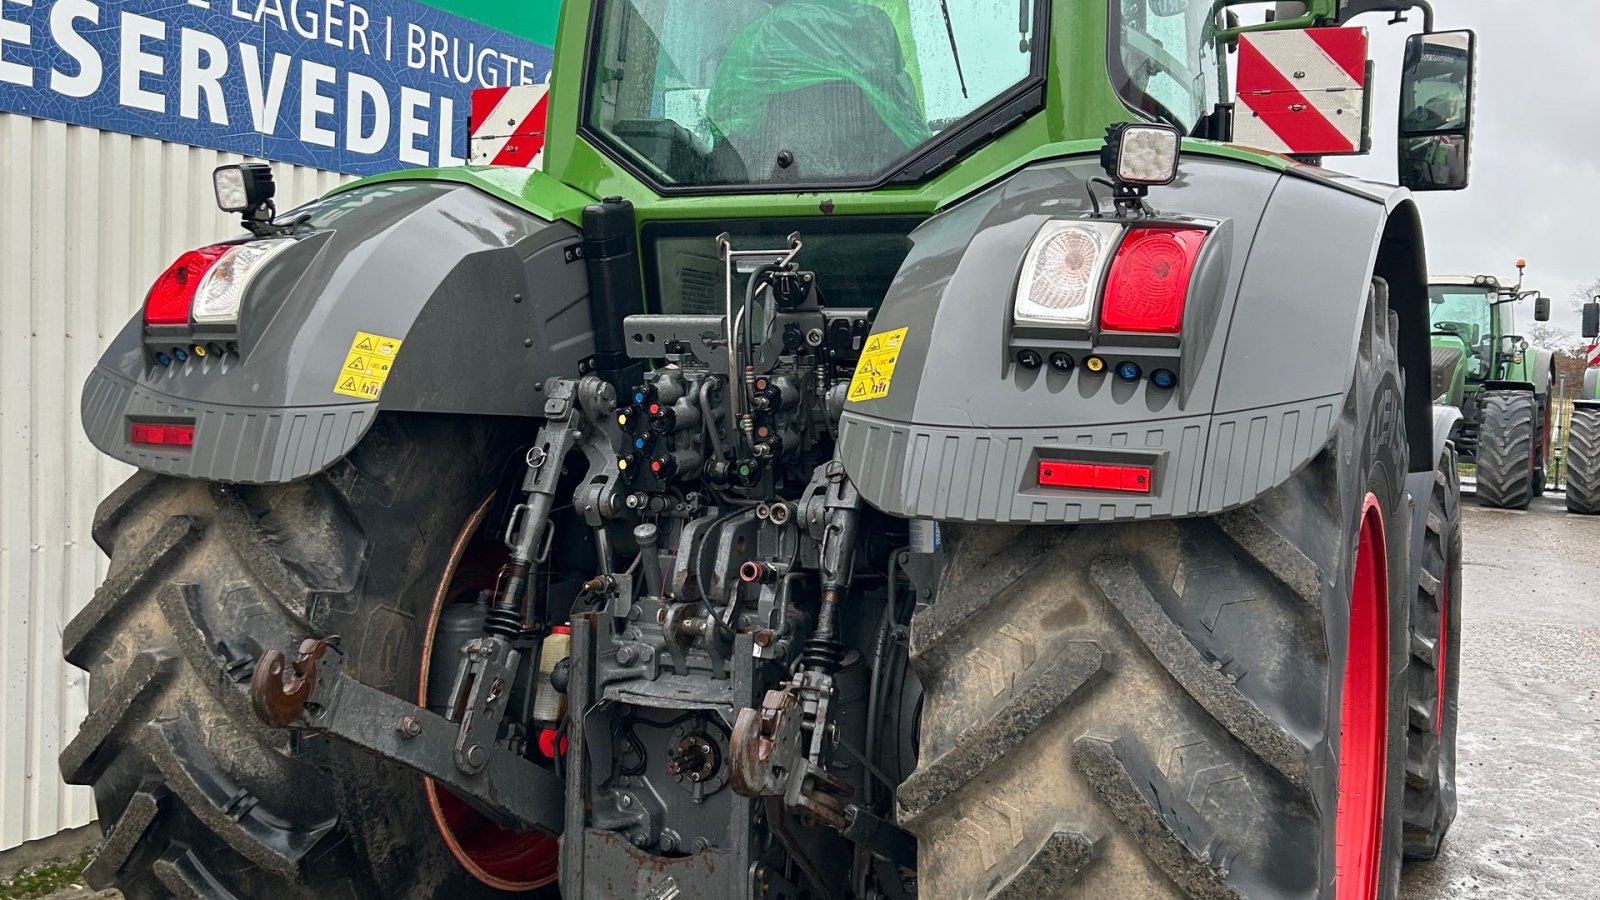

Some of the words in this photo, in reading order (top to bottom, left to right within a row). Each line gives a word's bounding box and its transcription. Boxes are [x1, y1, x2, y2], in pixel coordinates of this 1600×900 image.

[231, 0, 371, 55] LAGER
[385, 15, 392, 62] I
[407, 22, 535, 88] BRUGTE
